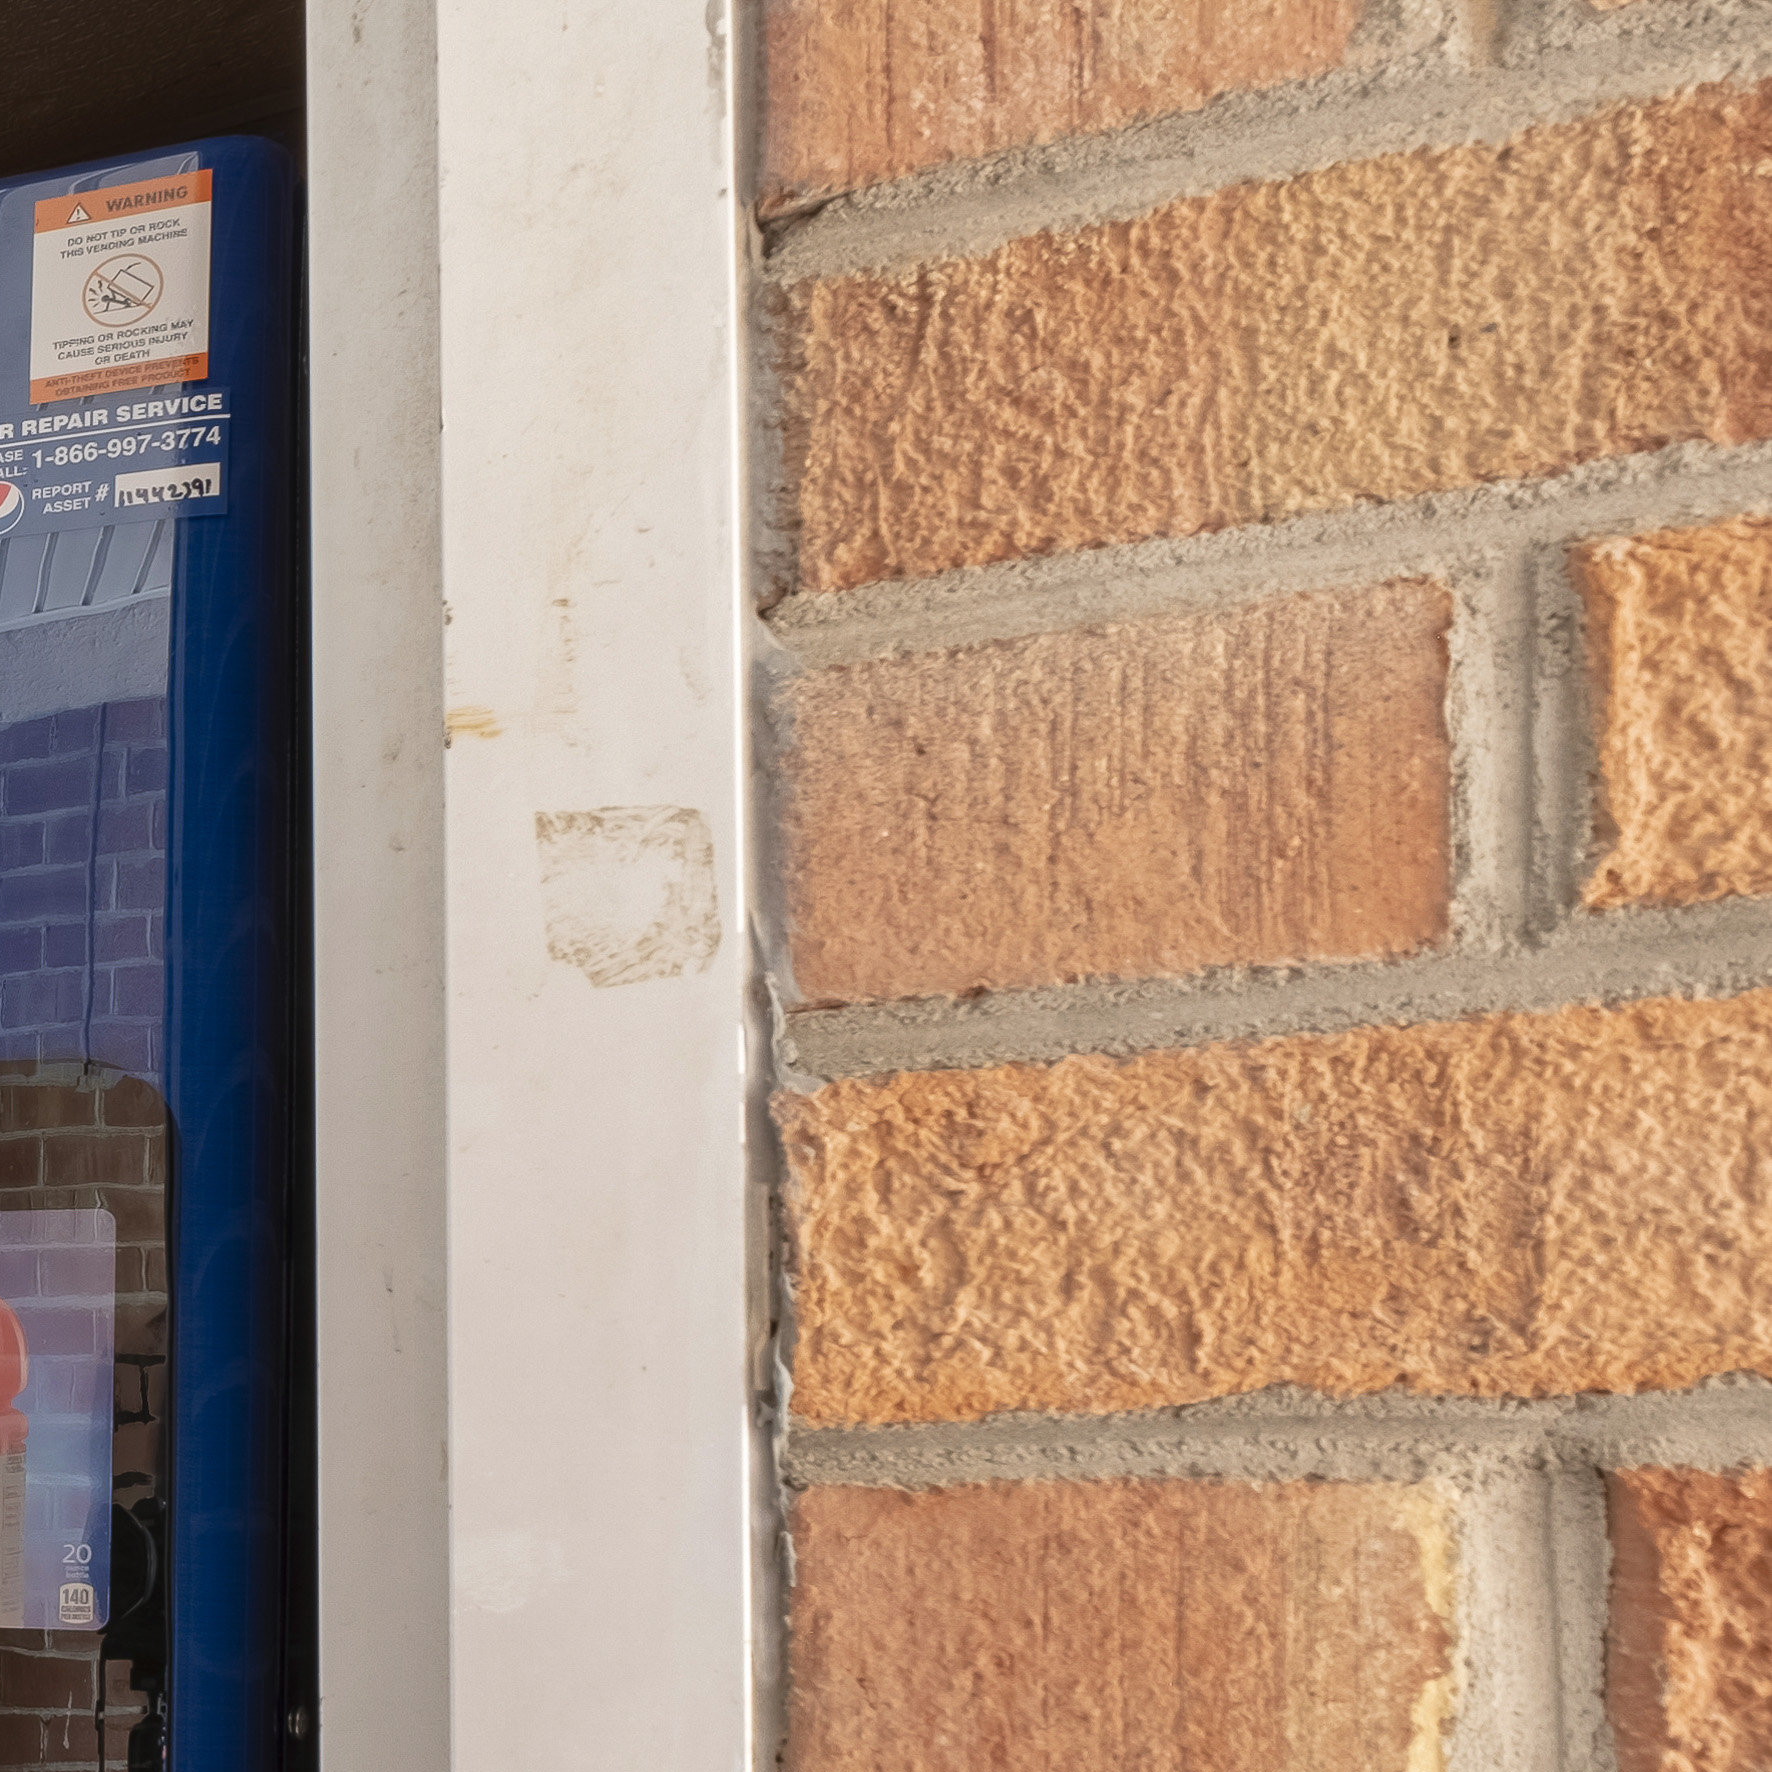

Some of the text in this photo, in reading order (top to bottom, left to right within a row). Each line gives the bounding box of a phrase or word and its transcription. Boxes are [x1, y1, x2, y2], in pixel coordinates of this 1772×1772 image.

[106, 185, 188, 213] WARNING
[60, 228, 188, 260] THIS VENDING MACHINE
[67, 218, 181, 248] DO NOT TIP OR ROCK
[52, 319, 195, 351] TIPPING OR ROCKING MAY
[57, 331, 189, 361] CAUSE SERIOUS INJURY
[94, 349, 151, 366] OR DEATH
[44, 356, 200, 389] ANTI-THEFT DEVICE PREVENTS
[55, 368, 192, 397] OBTAINING FREE PRODUCT
[21, 409, 108, 437] REPAIR
[116, 393, 223, 423] SERVICE
[31, 425, 222, 469] 1-866-997-3774
[32, 481, 93, 500] REPORT
[95, 482, 111, 502] #
[43, 497, 92, 514] ASSET
[62, 1544, 92, 1564] 20
[62, 1588, 89, 1605] 140
